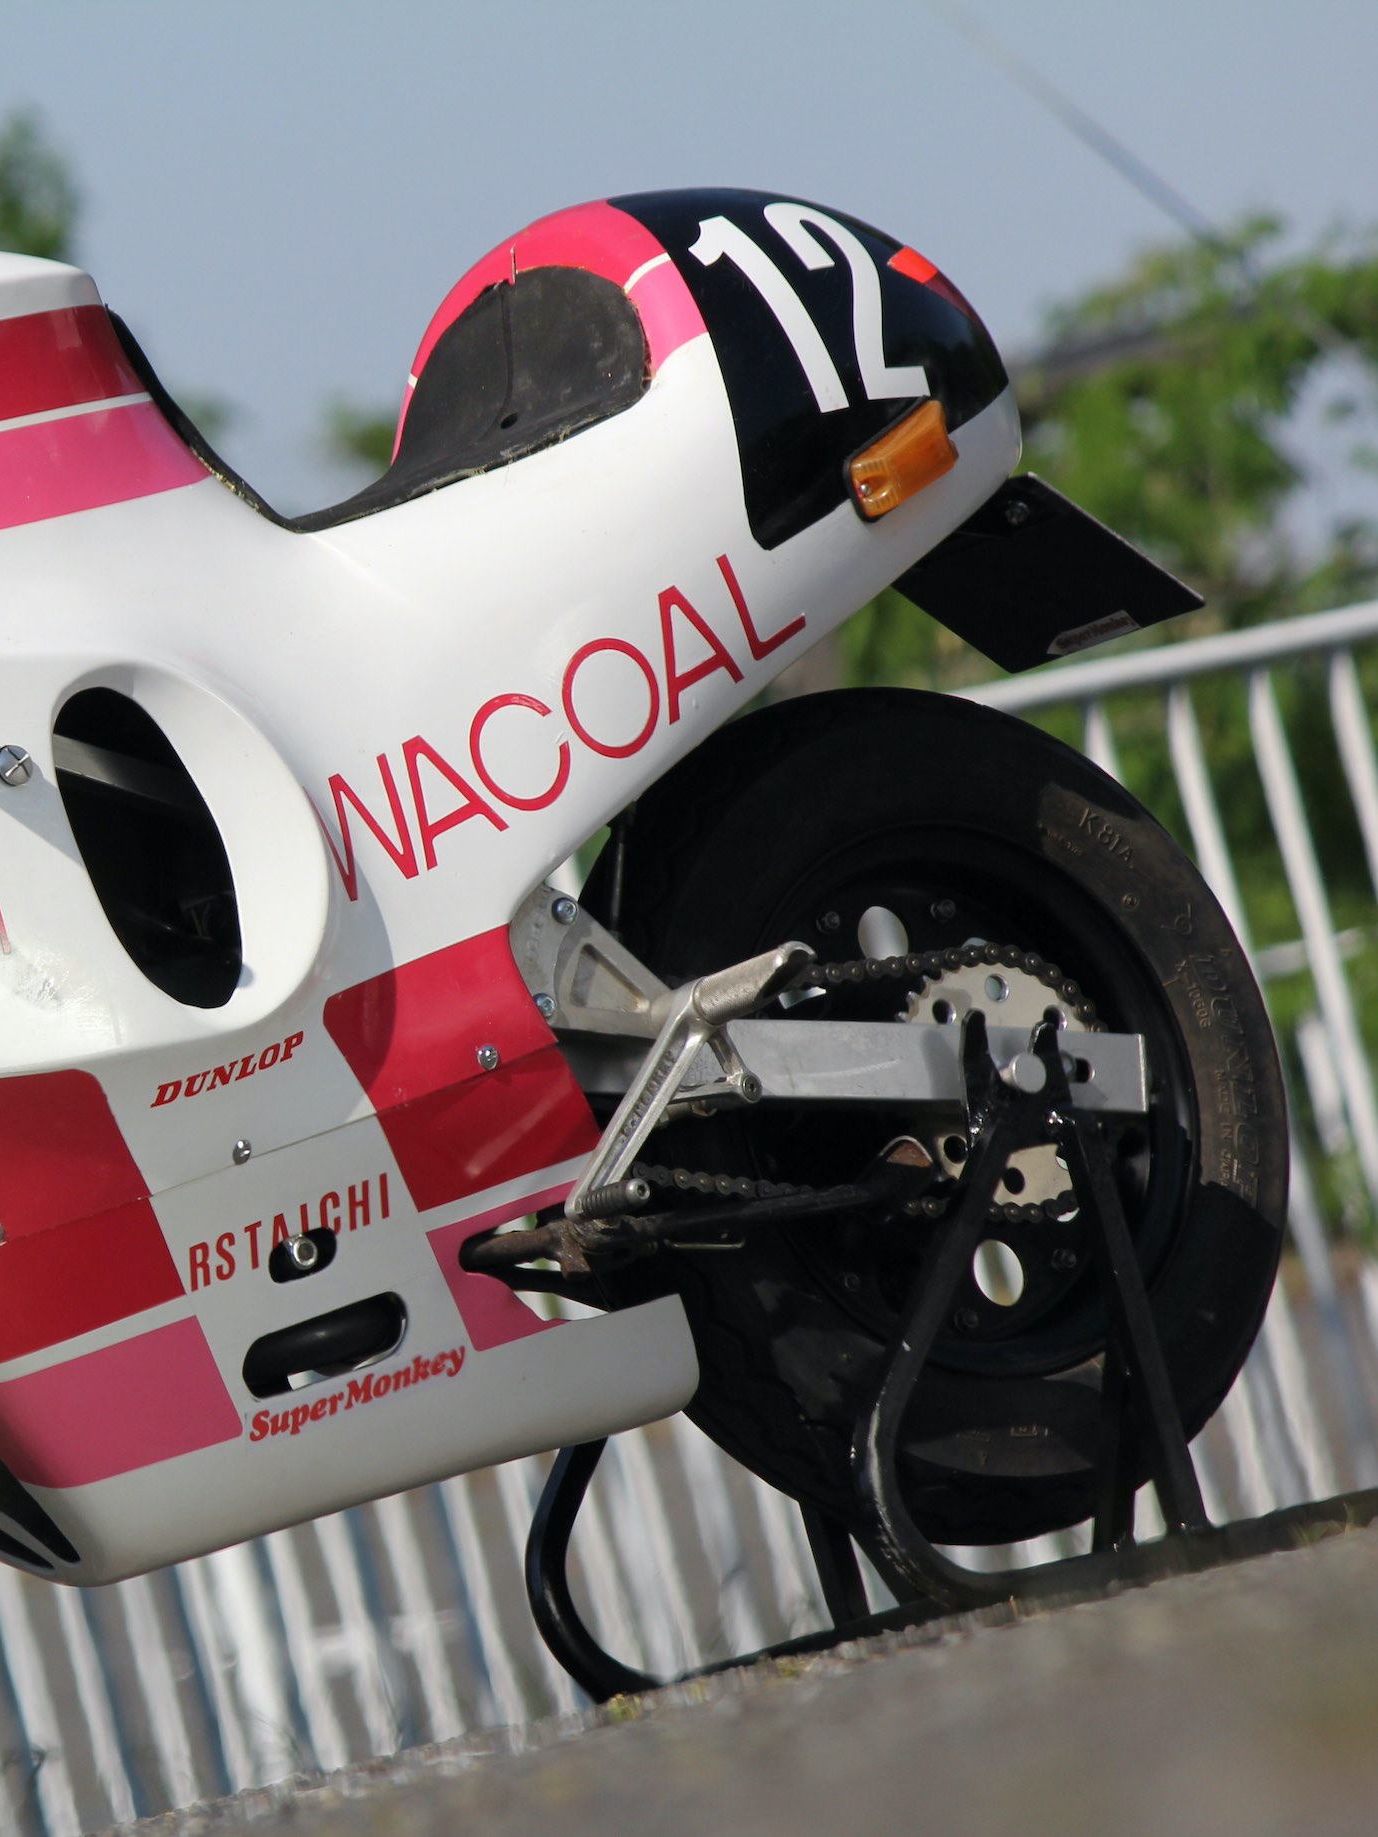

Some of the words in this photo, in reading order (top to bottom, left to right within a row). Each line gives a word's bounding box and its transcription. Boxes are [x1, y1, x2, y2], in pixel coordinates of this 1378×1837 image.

[688, 202, 931, 413] 12
[304, 553, 806, 902] WACOAL
[150, 1030, 304, 1108] DUNLOP
[248, 1344, 467, 1442] SuperMonkey
